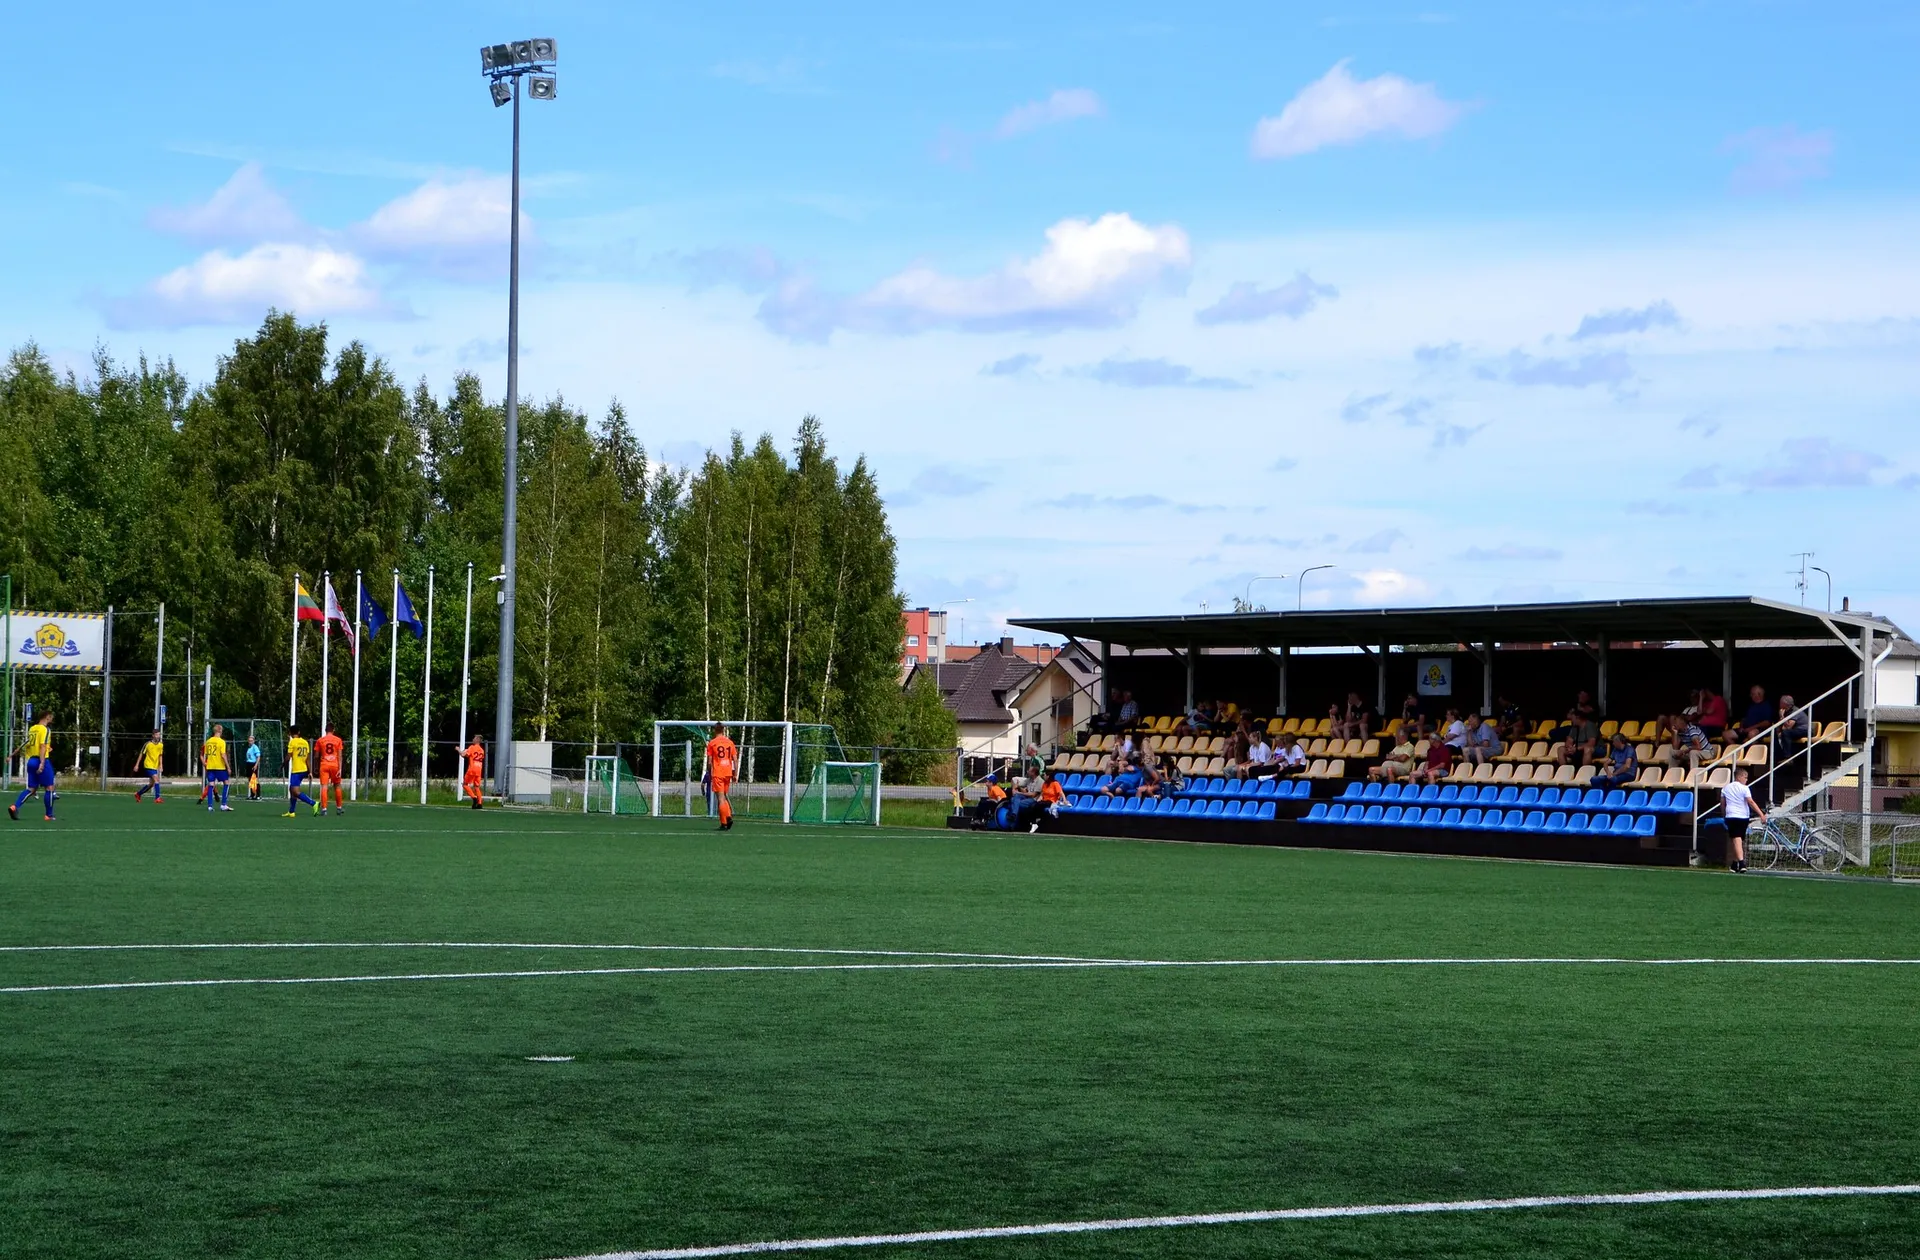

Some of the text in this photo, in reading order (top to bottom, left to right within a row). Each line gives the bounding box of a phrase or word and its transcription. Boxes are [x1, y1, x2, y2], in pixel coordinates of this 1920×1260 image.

[325, 743, 334, 754] 8
[717, 745, 731, 758] 81
[473, 752, 484, 762] 22
